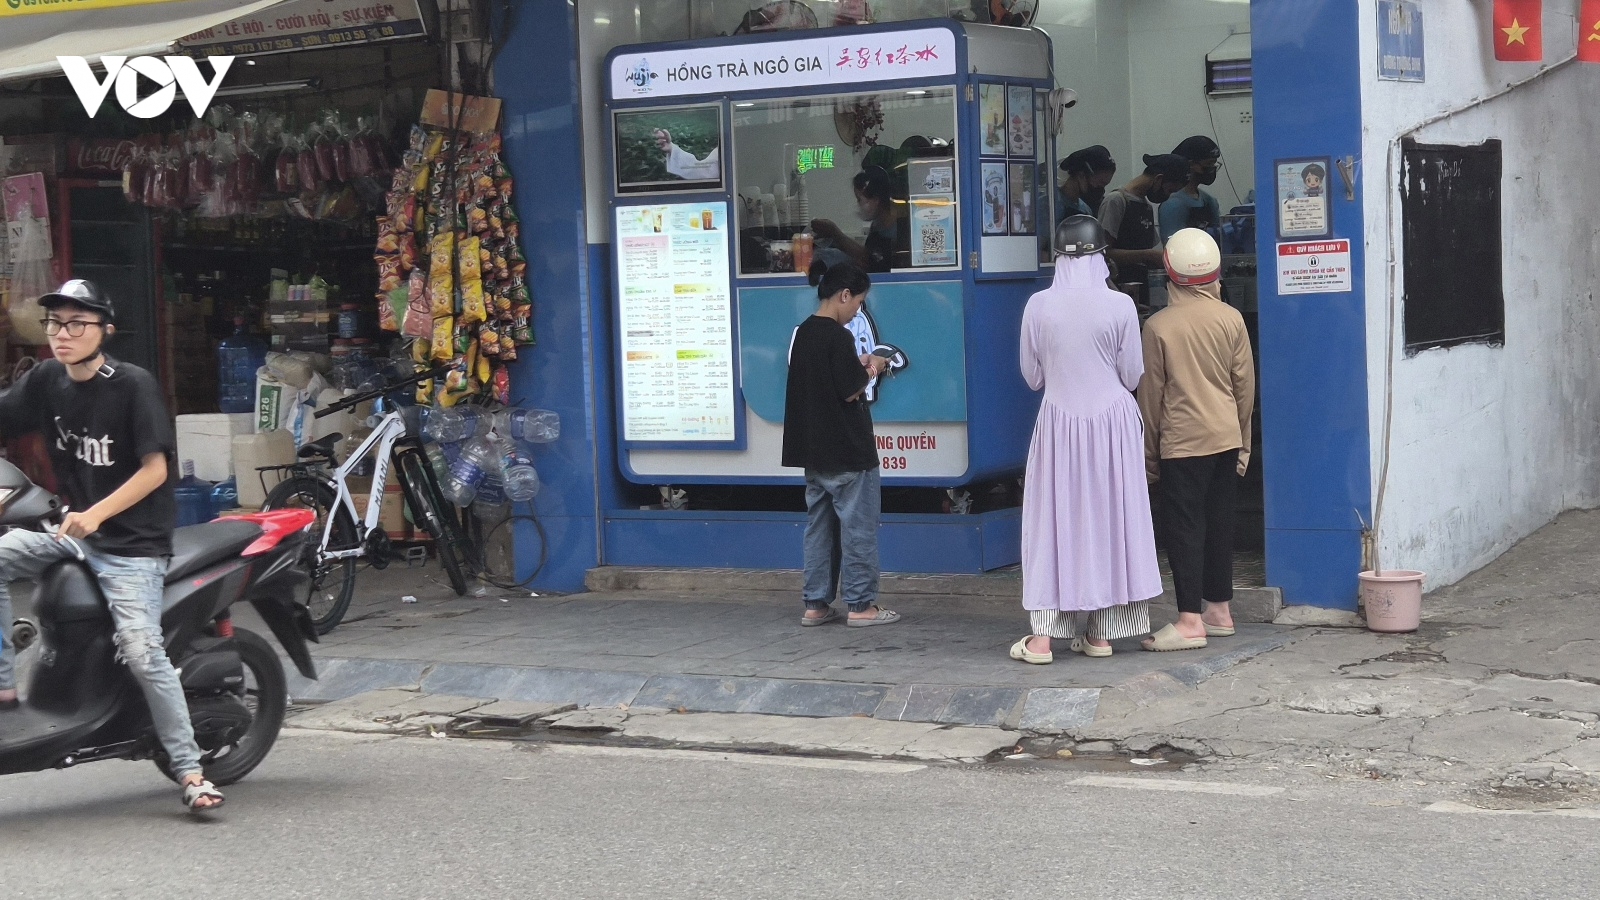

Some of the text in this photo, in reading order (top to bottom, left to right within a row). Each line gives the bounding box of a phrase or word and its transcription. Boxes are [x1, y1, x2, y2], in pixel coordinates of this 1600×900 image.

[667, 55, 822, 82] HỒNG TRÀ NGÔ GIA
[875, 430, 936, 451] NG QUYỀN
[882, 456, 907, 470] 839
